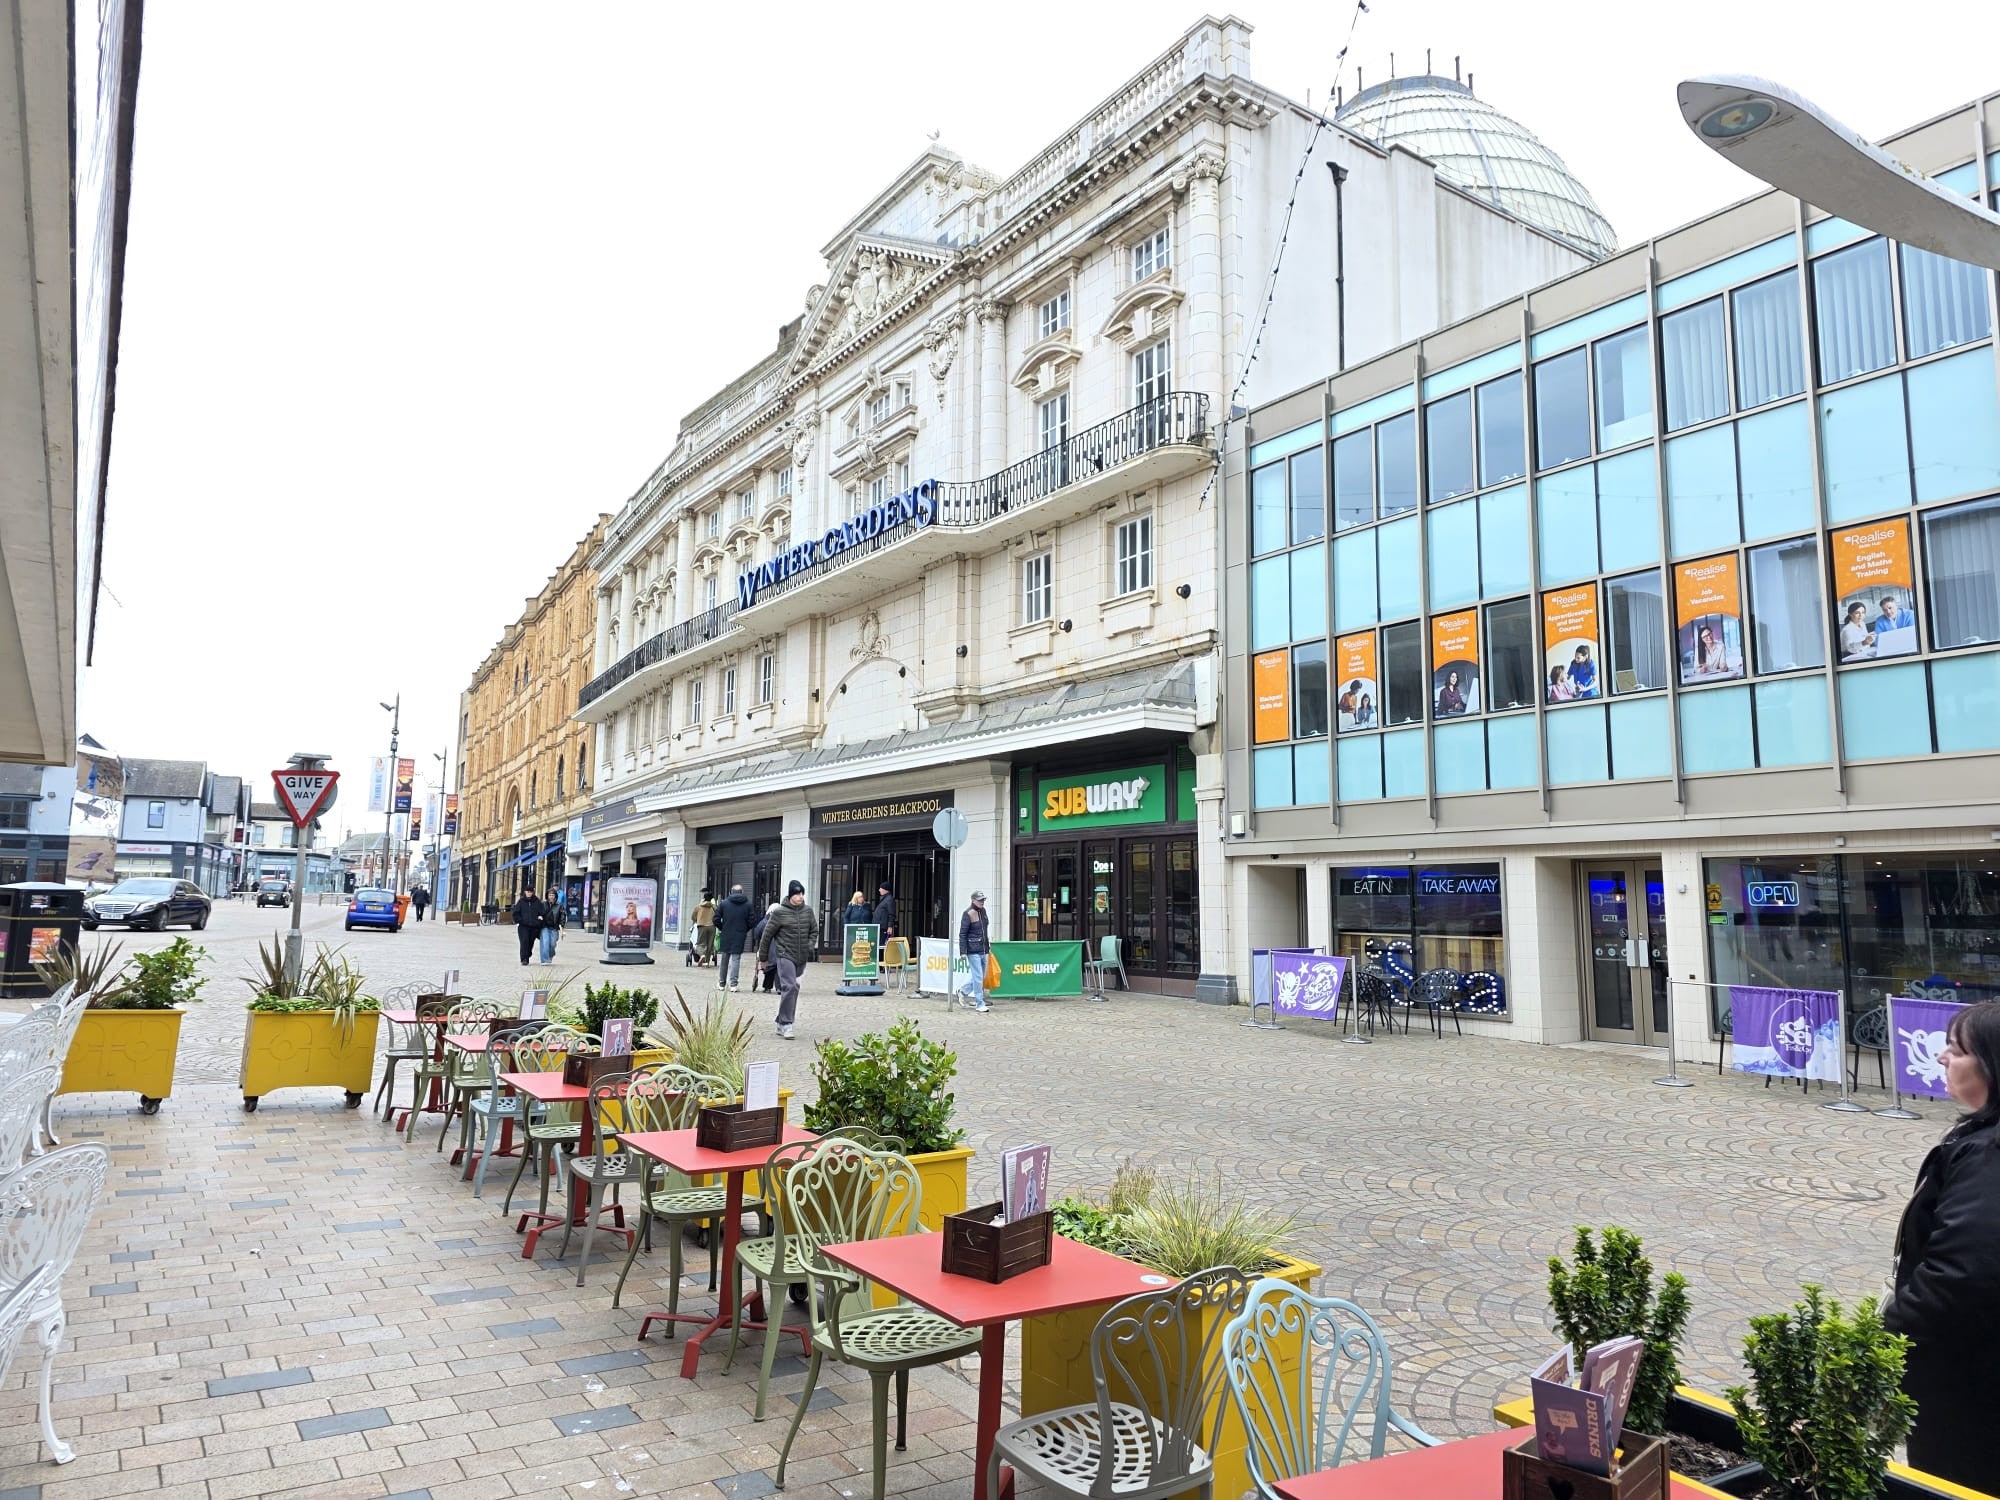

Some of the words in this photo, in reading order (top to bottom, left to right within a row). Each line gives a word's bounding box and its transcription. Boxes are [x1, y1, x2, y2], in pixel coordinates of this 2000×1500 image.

[1851, 529, 1896, 545] Realise
[737, 540, 815, 611] WINTER
[822, 478, 937, 560] GARDENS
[1856, 551, 1886, 563] English
[1691, 564, 1727, 578] Realise
[1851, 563, 1866, 572] and
[1867, 558, 1893, 569] Maths
[1856, 567, 1889, 578] Training
[1556, 593, 1588, 605] Realise
[1690, 594, 1725, 605] Vacancies
[1443, 618, 1470, 629] Realise
[285, 777, 323, 788] GIVE
[293, 791, 316, 799] WAY
[1043, 776, 1150, 819] SUBWAY
[822, 810, 850, 824] WINTER
[851, 805, 889, 820] GARDENS
[889, 799, 941, 816] BLACKPOOL
[1353, 880, 1377, 894] EAT
[1378, 880, 1392, 894] IN
[1422, 878, 1454, 894] TAKE
[1456, 878, 1498, 893] AWAY
[1751, 886, 1795, 903] OPEN
[1012, 963, 1060, 975] SUBWAY
[1910, 980, 1960, 1003] Sea
[1040, 1151, 1048, 1190] FOOD
[1619, 1348, 1640, 1409] FOOD
[1586, 1397, 1602, 1458] DRINKS
